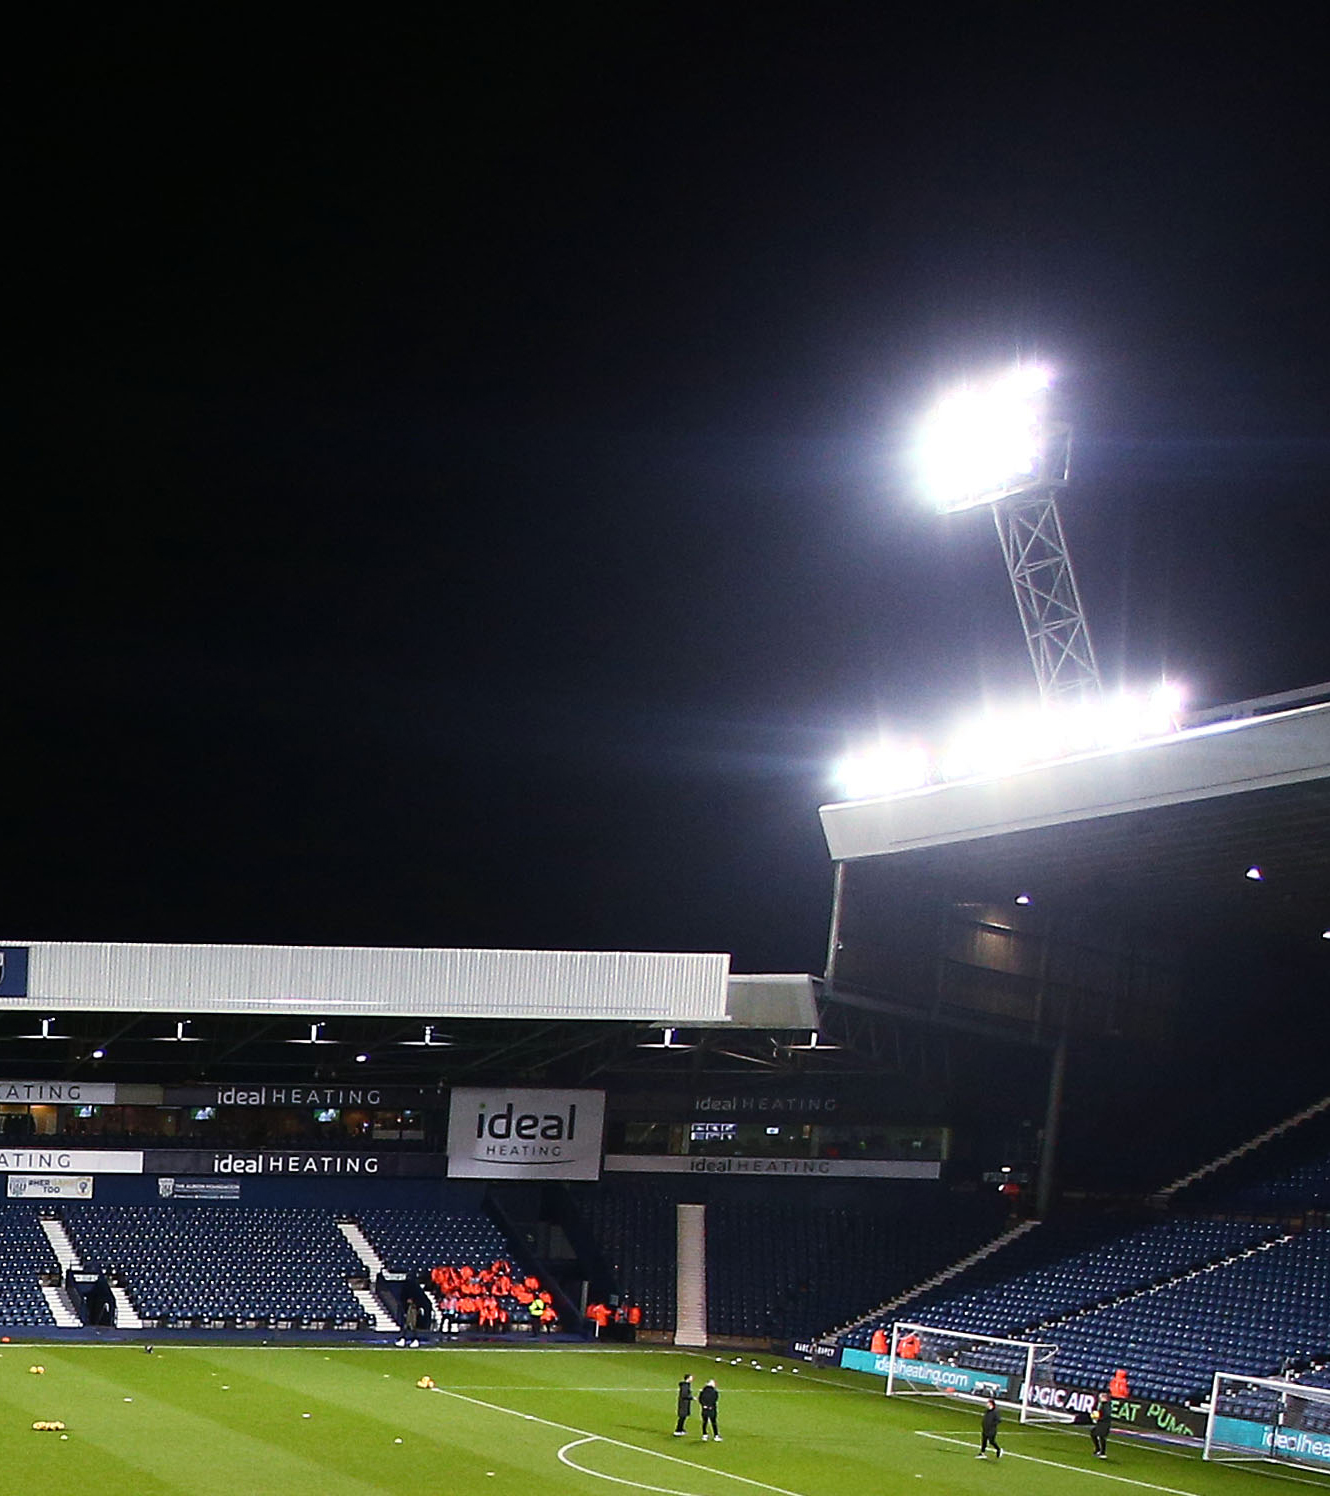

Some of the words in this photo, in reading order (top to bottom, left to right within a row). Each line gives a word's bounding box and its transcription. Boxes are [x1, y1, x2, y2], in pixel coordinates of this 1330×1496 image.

[218, 1088, 265, 1104] ideal
[273, 1090, 379, 1104] HEATING
[695, 1096, 736, 1112] ideal
[742, 1098, 838, 1112] HEATING
[476, 1103, 575, 1141] ideal
[486, 1145, 561, 1157] HEATING
[215, 1155, 262, 1172] ideal
[270, 1157, 377, 1172] HEATING
[690, 1157, 732, 1173] ideal
[737, 1158, 832, 1174] HEATING
[1067, 1391, 1095, 1413] AIR
[1110, 1399, 1141, 1422] EAT
